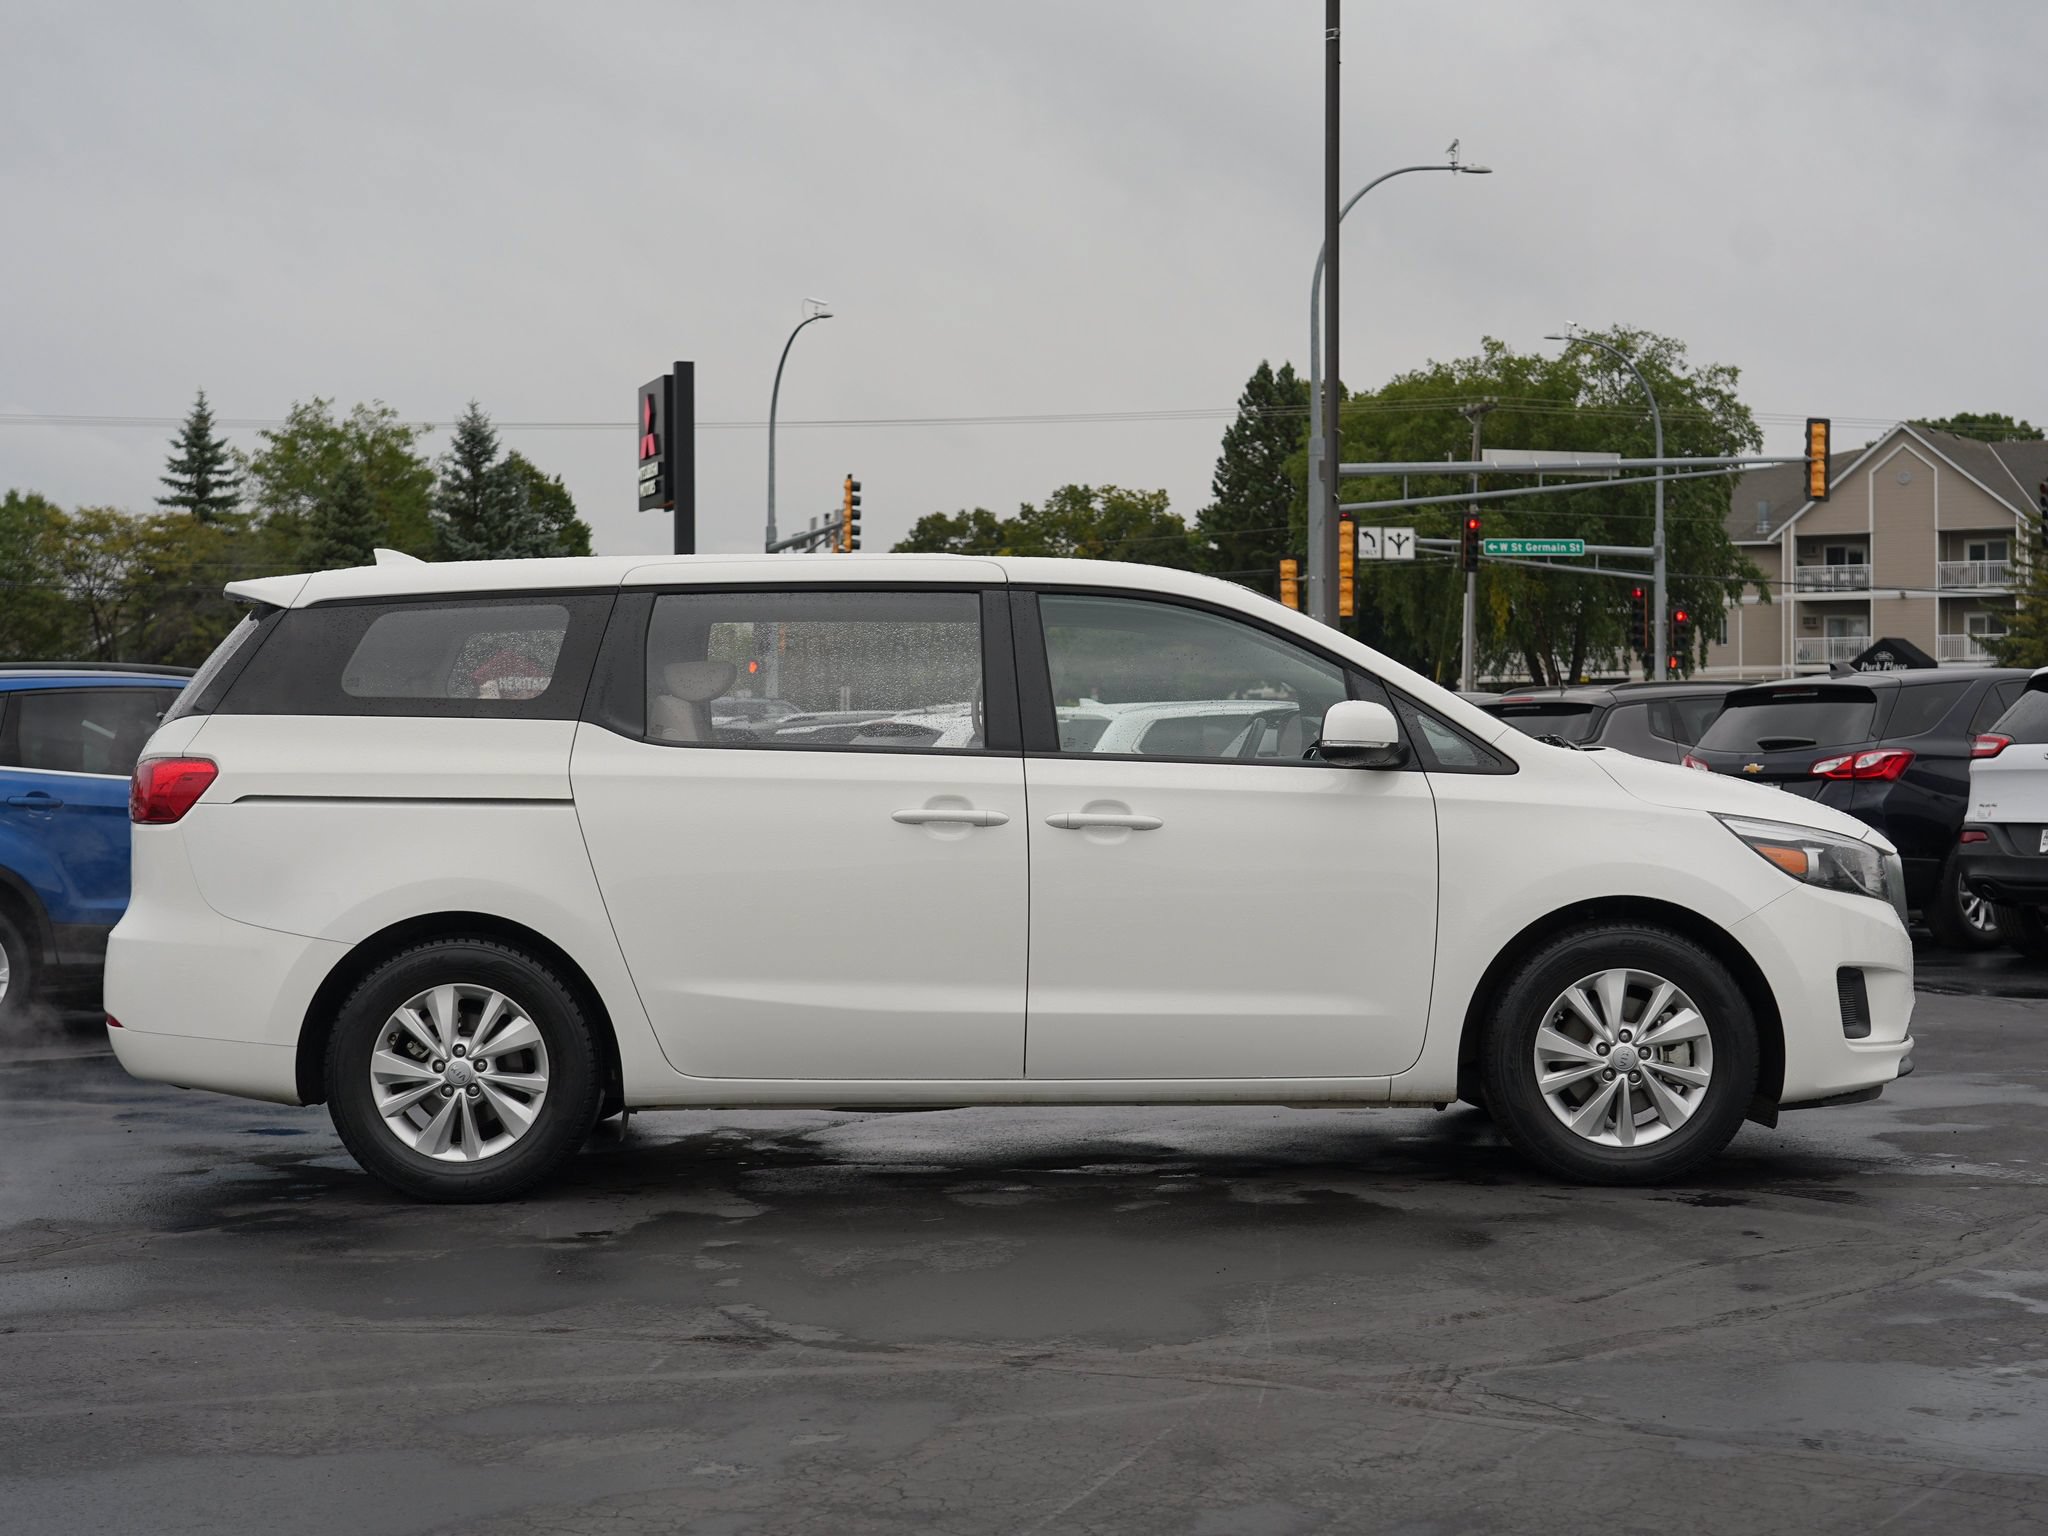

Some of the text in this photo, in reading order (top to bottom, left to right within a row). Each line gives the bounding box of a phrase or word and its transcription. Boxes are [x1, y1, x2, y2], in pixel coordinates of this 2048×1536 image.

[1499, 543, 1581, 552] W St Germain St
[1860, 661, 1908, 671] Park Place
[499, 677, 552, 691] HERITAG
